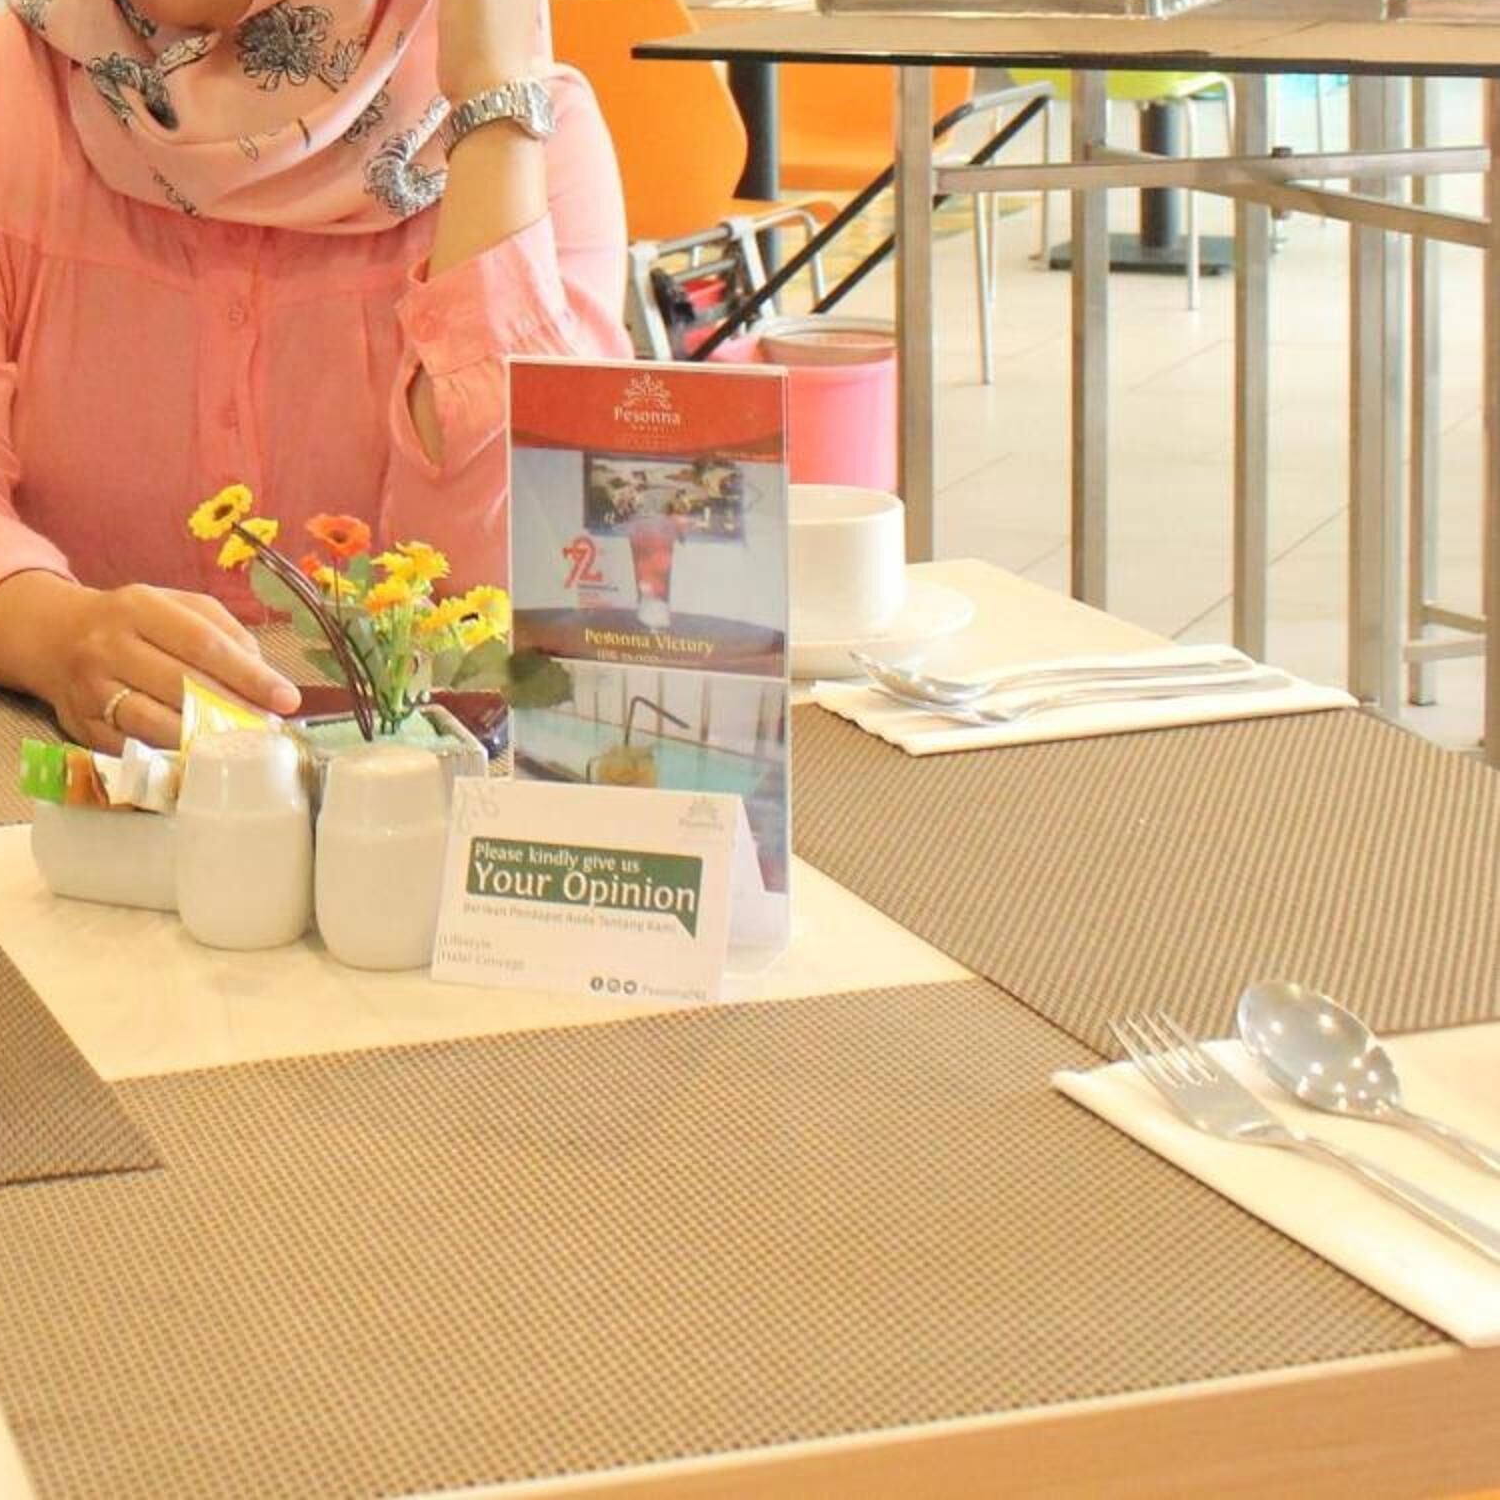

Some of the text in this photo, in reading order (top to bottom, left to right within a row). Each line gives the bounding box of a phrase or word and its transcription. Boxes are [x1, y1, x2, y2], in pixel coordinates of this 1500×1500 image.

[613, 405, 681, 426] Pesonna
[584, 627, 651, 649] Pesonna
[654, 632, 715, 658] Victory
[474, 841, 641, 873] Please kindly give us
[474, 860, 696, 913] Your Opinion
